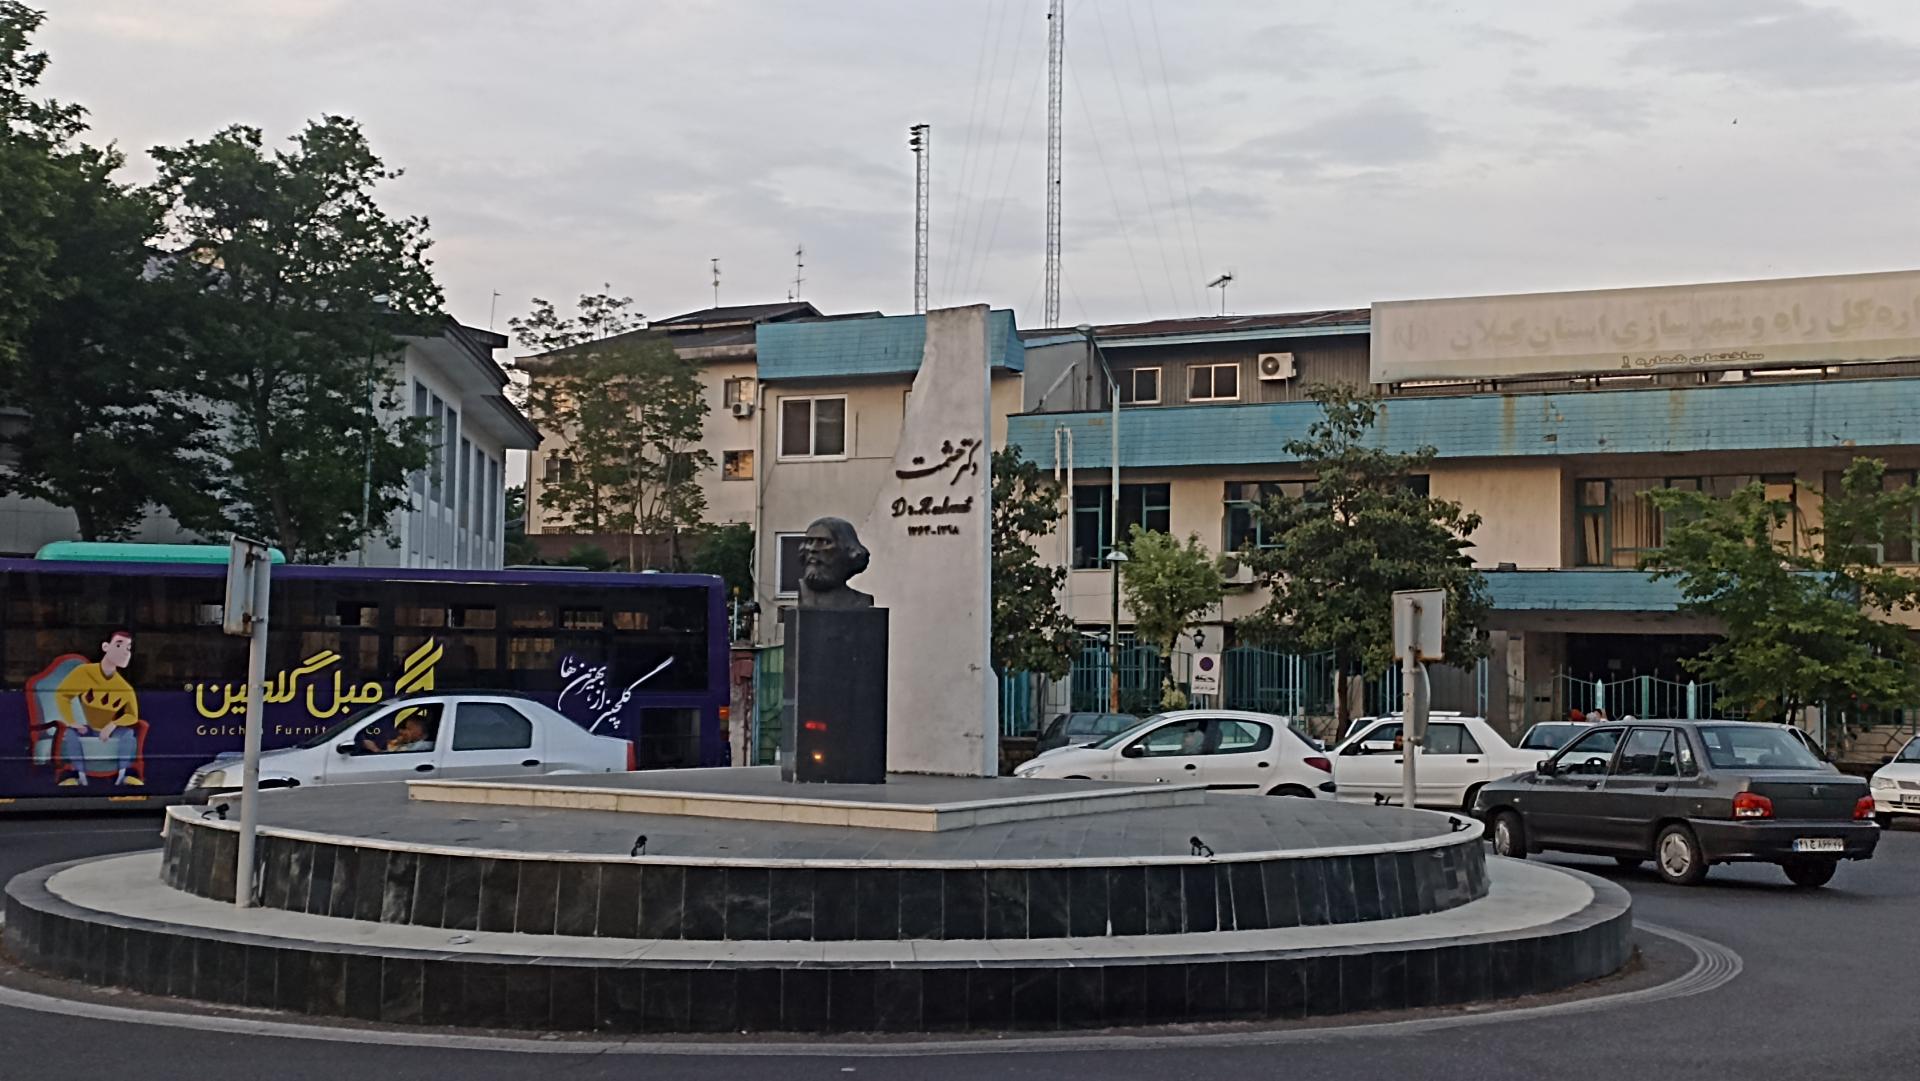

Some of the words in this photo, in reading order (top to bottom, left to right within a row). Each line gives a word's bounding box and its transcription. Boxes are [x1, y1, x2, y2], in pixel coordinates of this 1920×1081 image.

[1775, 303, 1817, 338] راه
[1635, 353, 1687, 368] شماره
[1689, 350, 1764, 366] ساختمان
[895, 440, 966, 480] حشمت
[306, 669, 383, 719] مبل
[196, 725, 263, 736] Golch
[275, 725, 327, 736] Furnit
